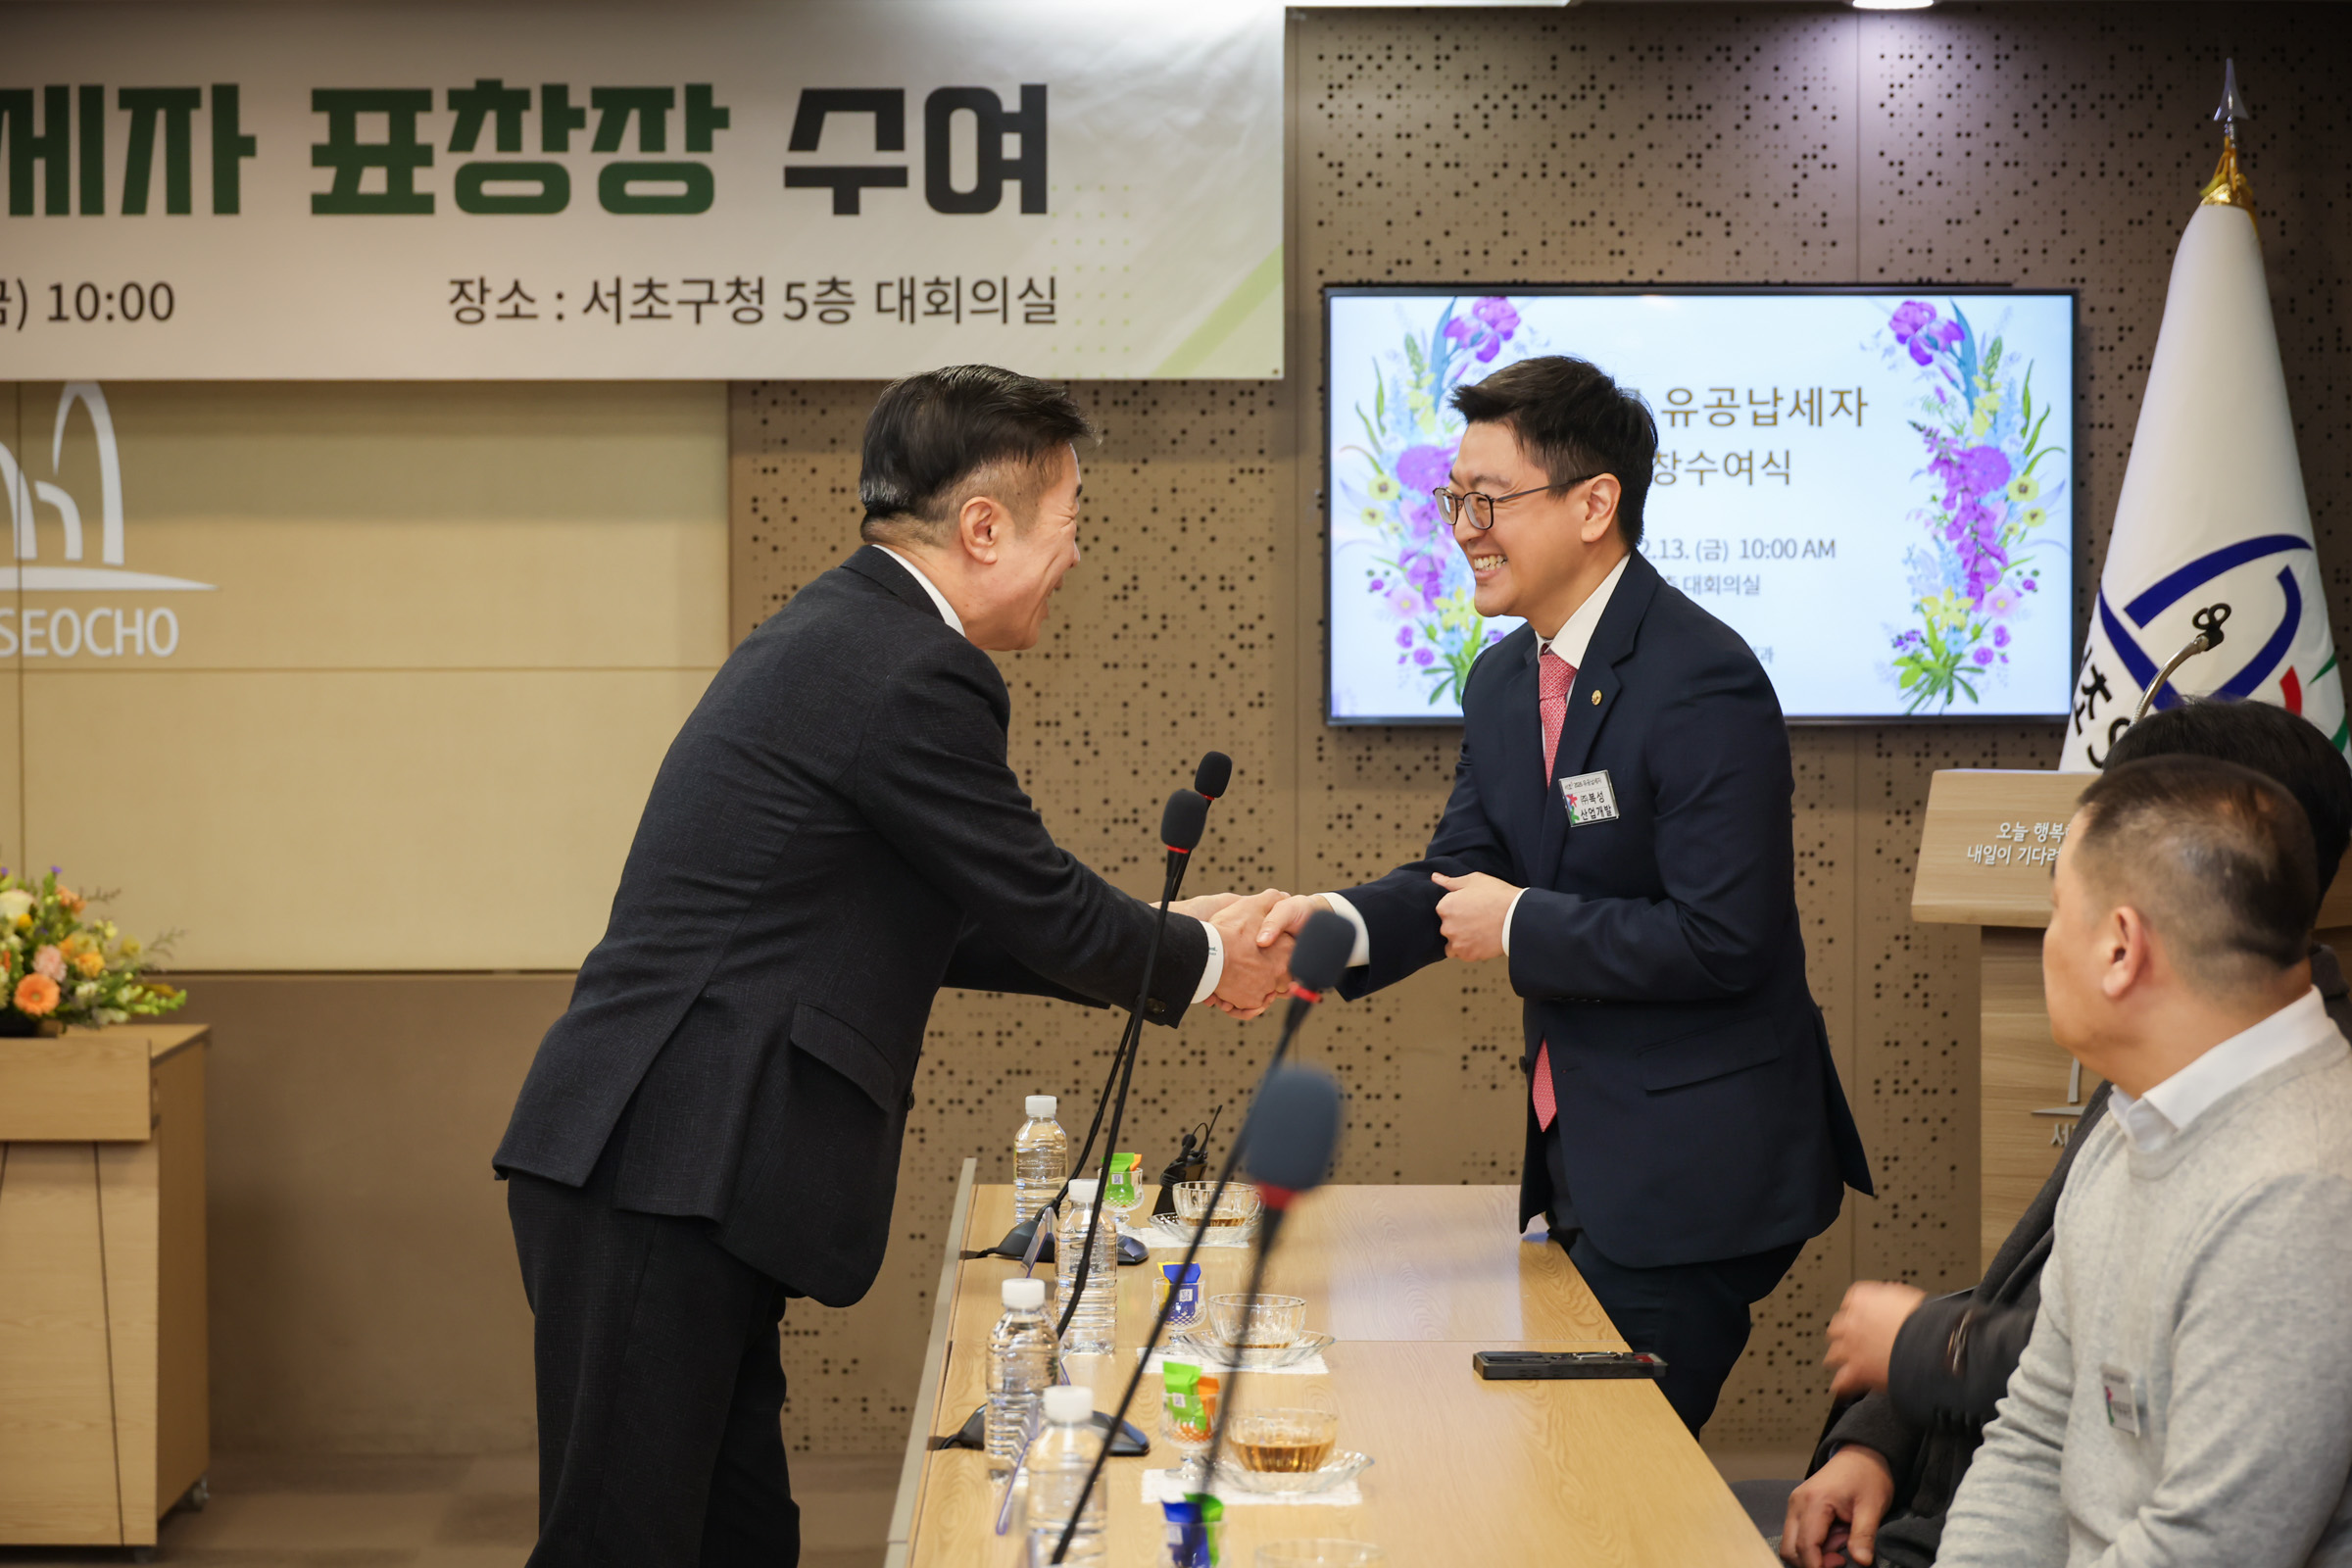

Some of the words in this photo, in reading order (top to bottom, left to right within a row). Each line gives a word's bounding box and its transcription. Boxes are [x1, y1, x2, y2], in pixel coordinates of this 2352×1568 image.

[311, 78, 731, 216] 표창장
[784, 83, 1049, 216] 수여
[47, 281, 174, 322] 10:00
[448, 275, 538, 326] 장소
[582, 275, 766, 325] 서초구청
[782, 275, 857, 325] 5층
[875, 275, 1057, 325] 대회의실
[1661, 386, 1869, 428] 유공납세자
[1695, 539, 1729, 563] (금)
[1740, 538, 1798, 560] 10:00
[1801, 539, 1837, 560] AM
[1683, 574, 1761, 596] 대회의실
[0, 607, 180, 658] SEOCHO
[1581, 804, 1612, 820] 산업개발
[1995, 821, 2030, 843] 오늘
[1967, 844, 2012, 865] 내일이
